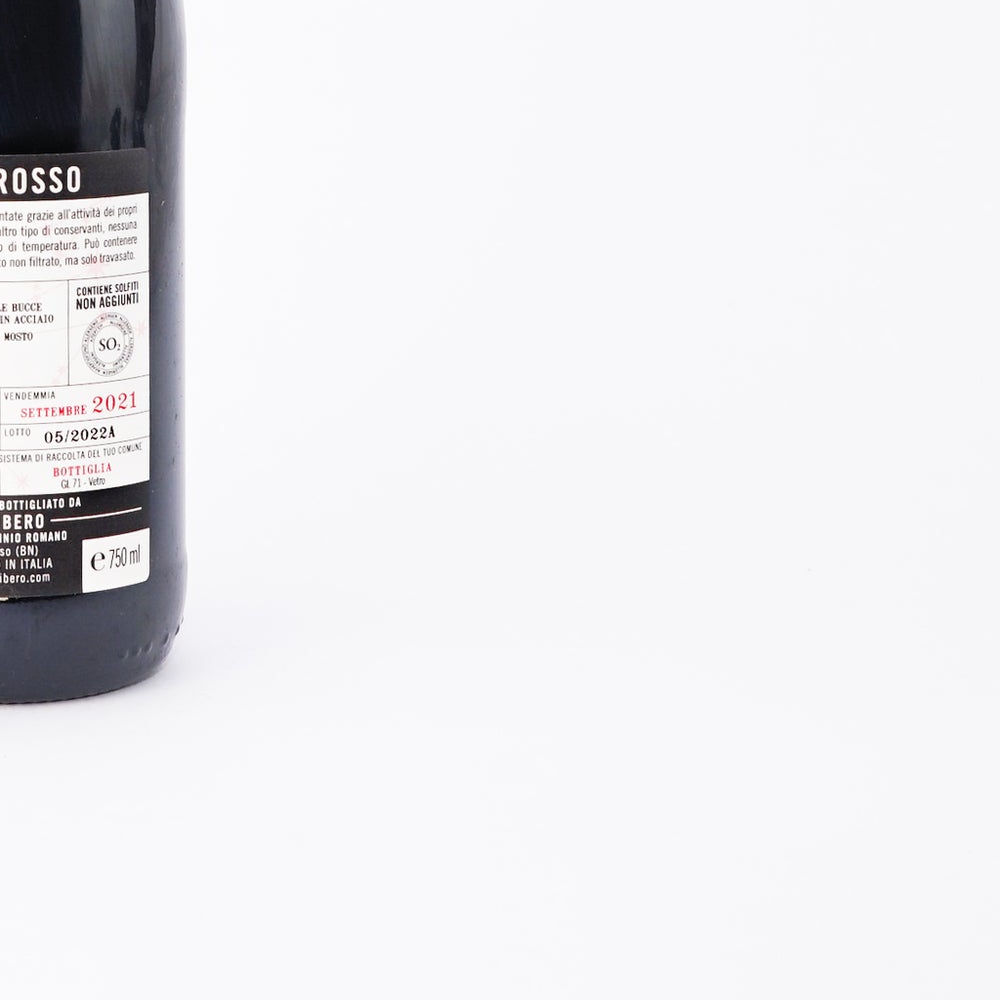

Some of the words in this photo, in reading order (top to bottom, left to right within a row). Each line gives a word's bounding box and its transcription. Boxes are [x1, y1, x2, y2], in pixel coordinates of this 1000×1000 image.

[27, 210, 54, 222] grazie
[104, 206, 116, 217] dei
[118, 203, 138, 217] propri
[21, 226, 39, 238] tipo
[42, 226, 51, 236] di
[54, 222, 105, 235] conservanti,
[108, 219, 137, 232] nessuna
[8, 241, 17, 252] di
[84, 237, 100, 249] Può
[103, 234, 138, 247] contenere
[9, 258, 26, 268] non
[29, 256, 62, 268] filtrato,
[64, 256, 79, 266] ma
[81, 252, 98, 265] solo
[99, 249, 135, 263] travasato.
[76, 284, 112, 297] CONTIENE
[115, 281, 139, 293] SOLFITI
[12, 302, 43, 312] BUCCE
[76, 297, 96, 310] NON
[99, 292, 139, 307] AGGIUNTI
[0, 315, 10, 324] IN
[14, 314, 54, 324] ACCIAIO
[4, 332, 33, 341] MOSTO
[4, 391, 56, 400] VENDEMMIA
[20, 404, 87, 418] SETTEMBRE
[92, 391, 137, 414] 2021
[4, 428, 31, 437] LOTTO
[44, 425, 116, 444] 05/2022A
[35, 454, 43, 463] DI
[47, 451, 85, 462] RACCOLTA
[88, 449, 100, 459] DEL
[103, 447, 117, 457] TUO
[118, 442, 142, 454] COMUNE
[53, 462, 112, 477] BOTTIGLIA
[73, 478, 81, 488] 71
[88, 477, 106, 487] Vetro
[69, 496, 81, 508] DA
[26, 530, 67, 542] ROMANO
[16, 545, 38, 557] (BN)
[109, 546, 127, 569] 750
[129, 543, 141, 565] ml
[5, 559, 16, 570] IN
[21, 557, 53, 569] ITALIA
